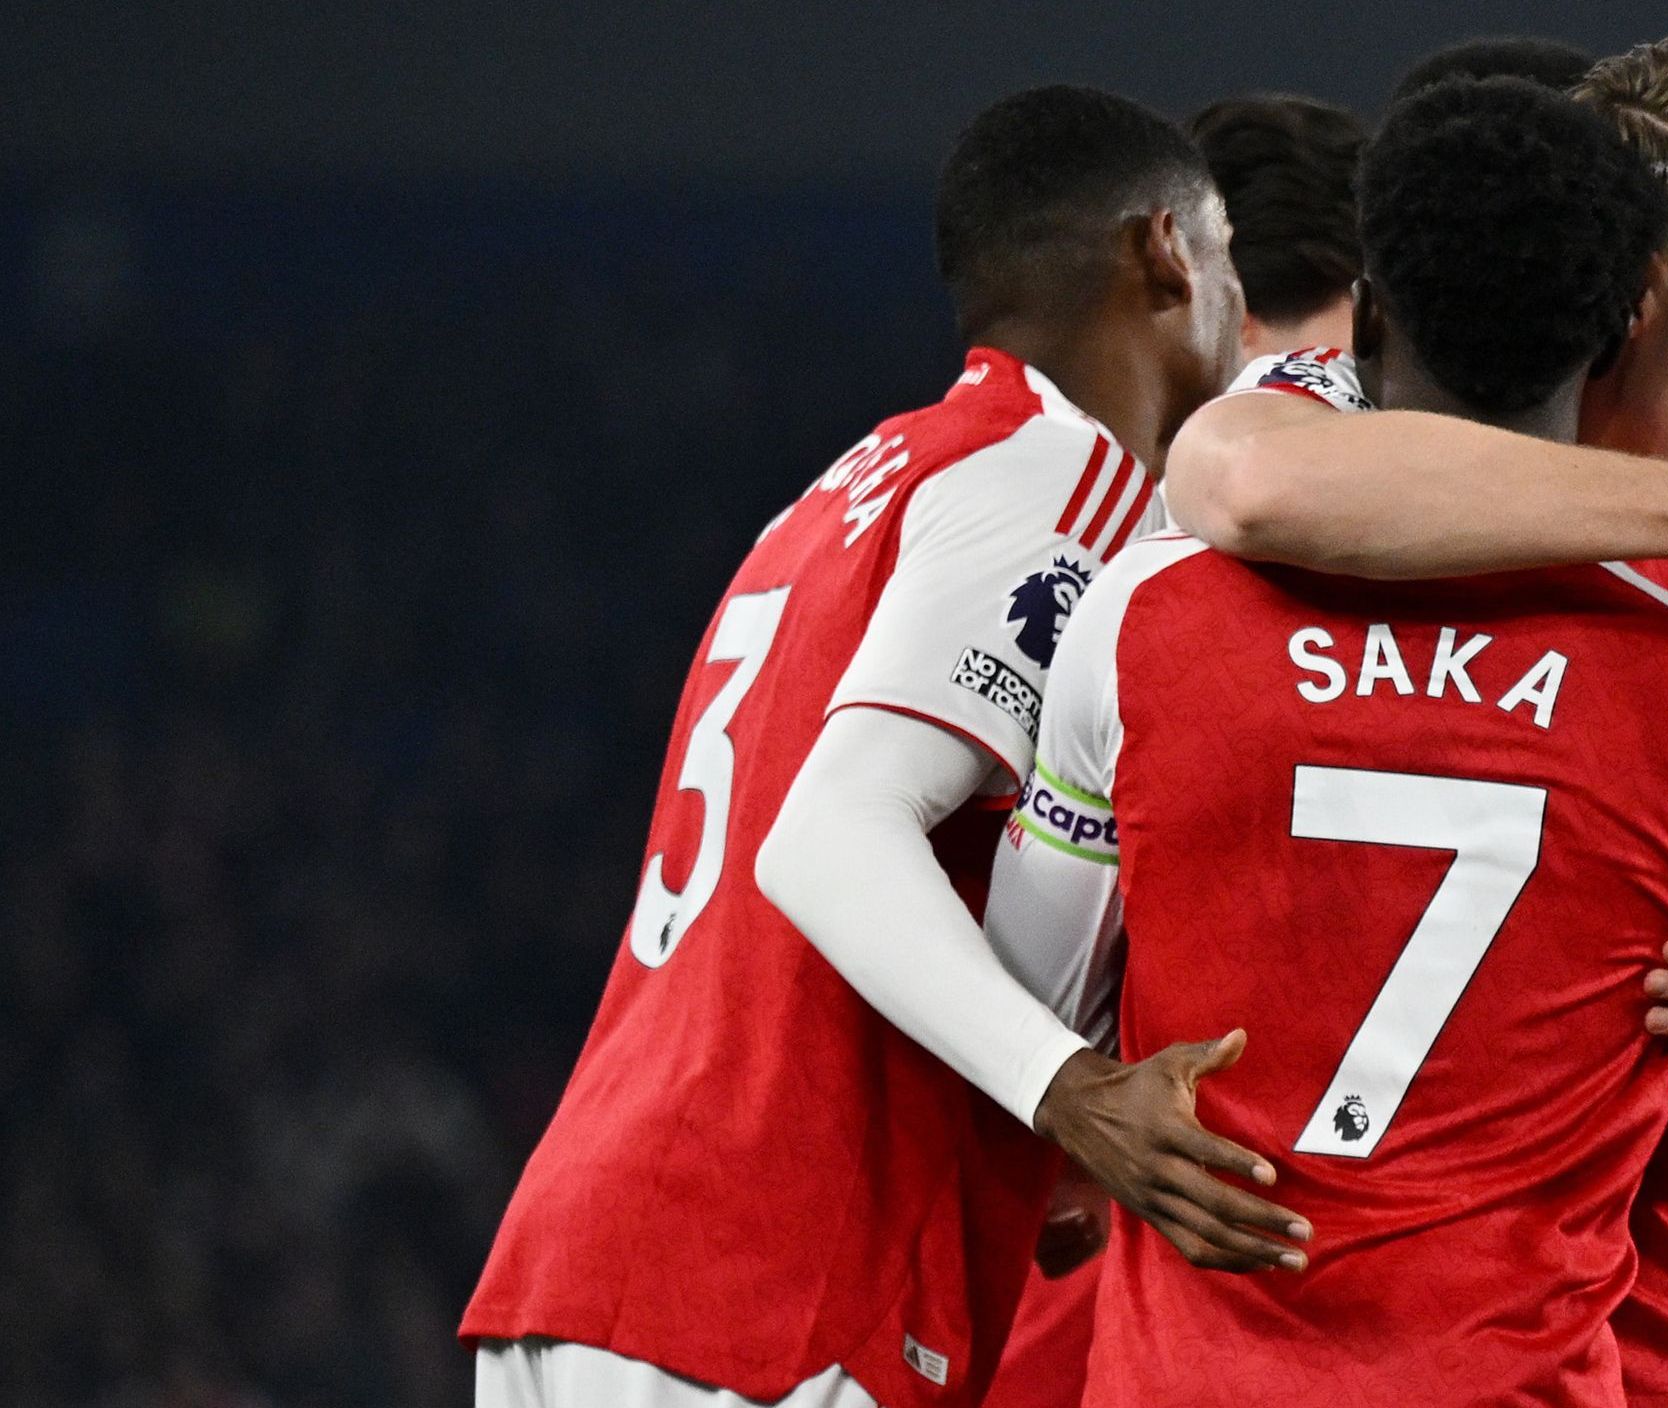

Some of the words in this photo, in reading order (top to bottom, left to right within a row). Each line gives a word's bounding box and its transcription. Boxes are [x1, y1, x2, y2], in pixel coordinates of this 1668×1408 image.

[629, 585, 792, 969] 3
[958, 648, 997, 677] No
[1287, 623, 1569, 729] SAKA
[1290, 764, 1548, 1159] 7
